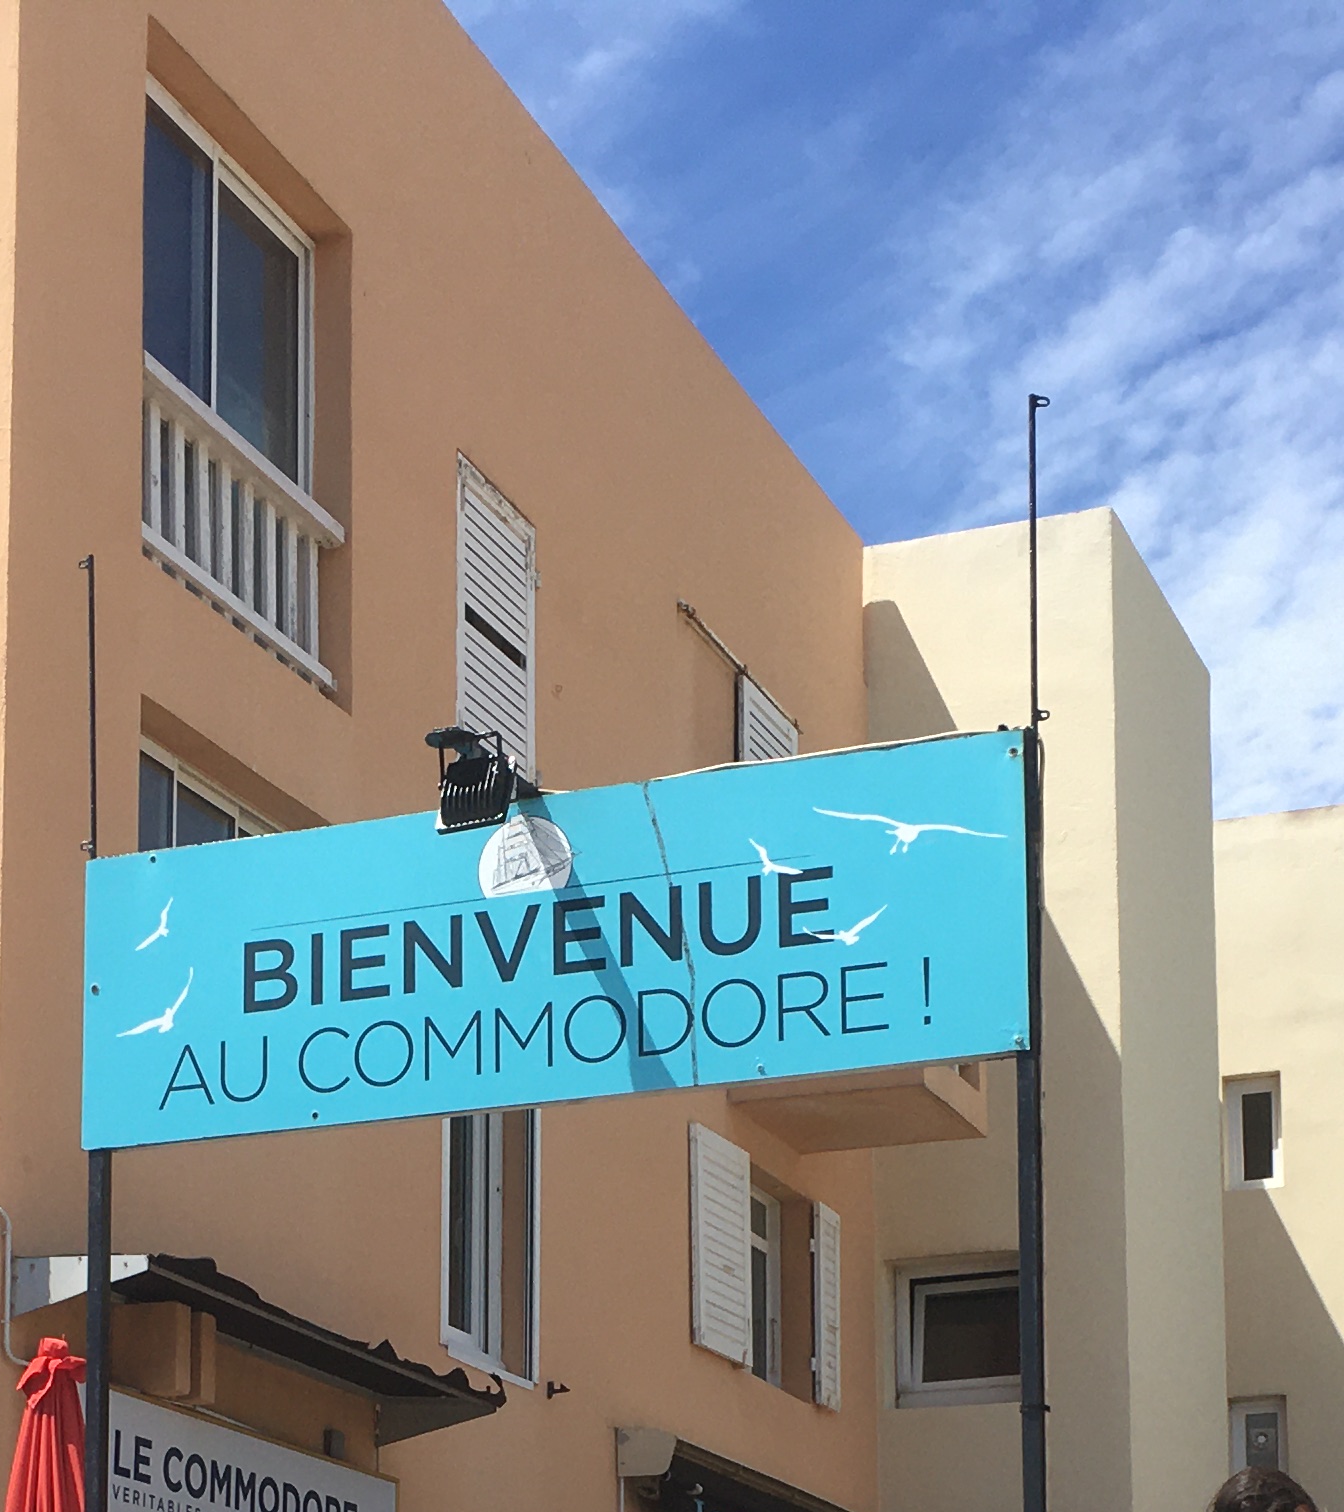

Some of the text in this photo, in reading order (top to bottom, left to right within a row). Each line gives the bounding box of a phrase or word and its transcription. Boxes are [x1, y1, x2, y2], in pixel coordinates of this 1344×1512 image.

[242, 864, 836, 1014] BIENVENUE
[159, 960, 890, 1112] AU COMMODORE
[113, 1429, 153, 1484] LE
